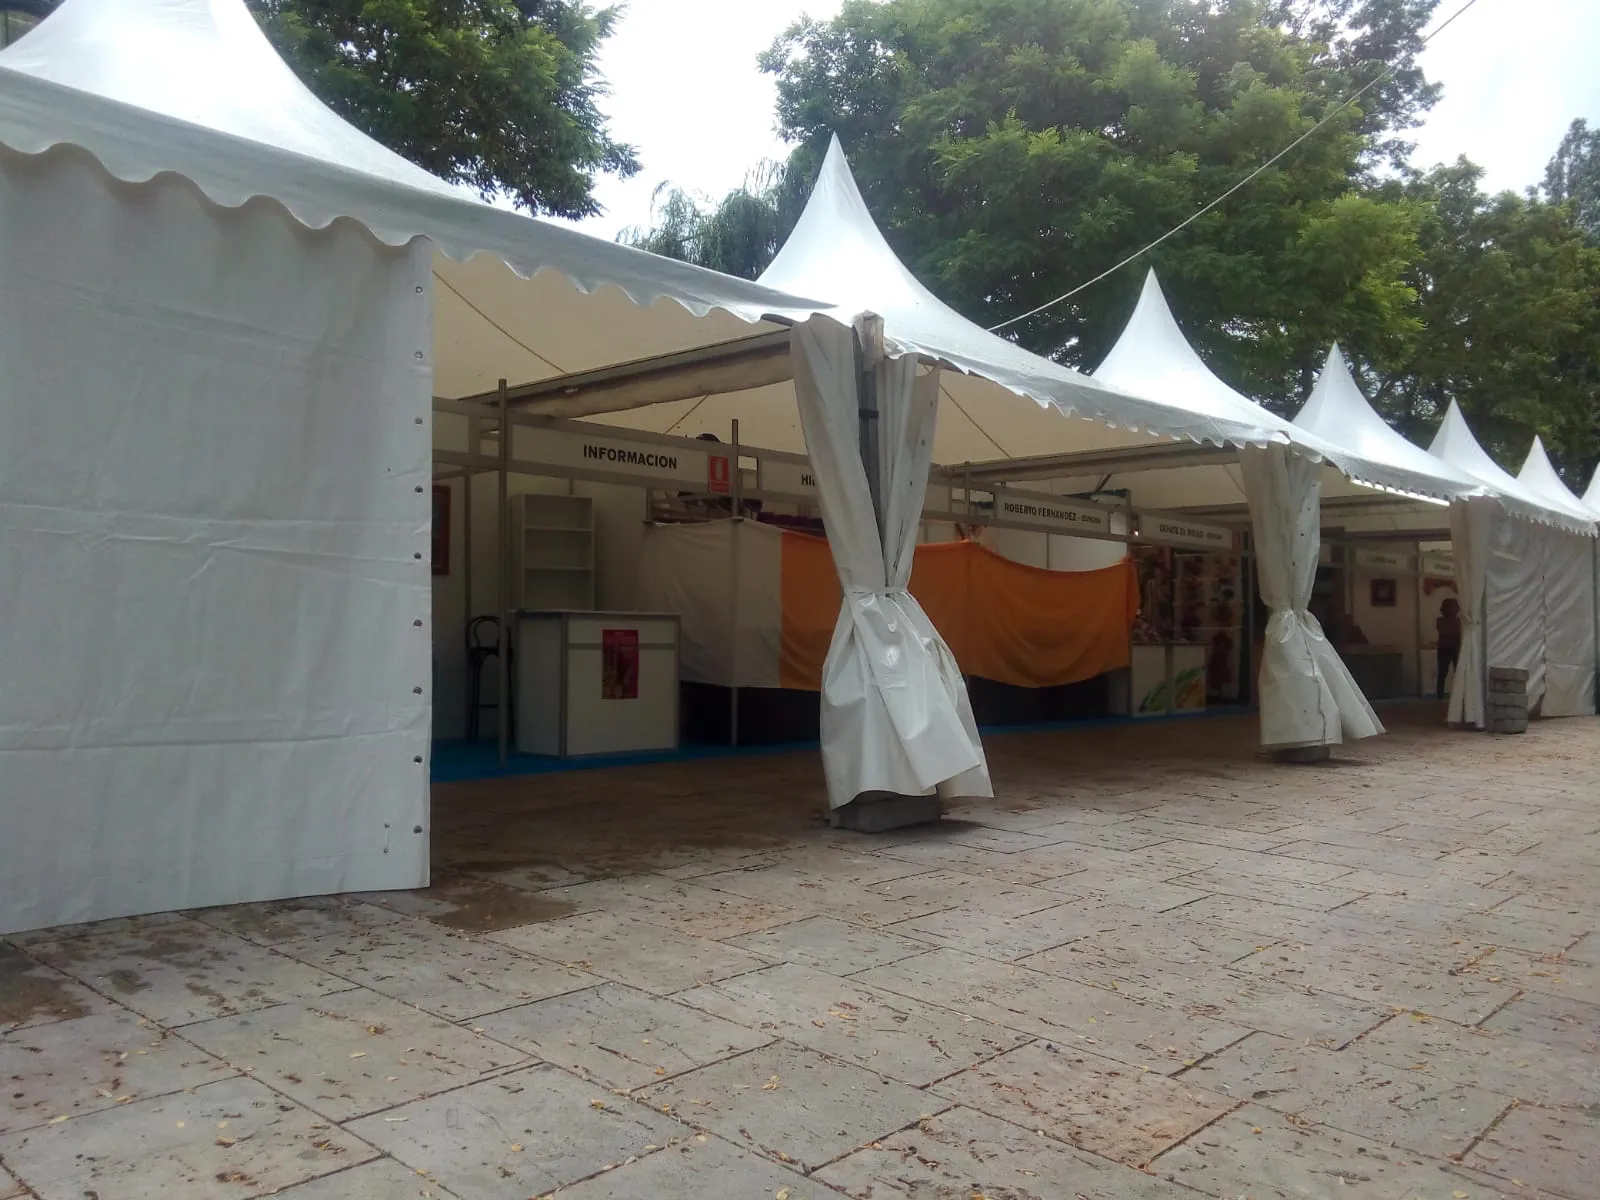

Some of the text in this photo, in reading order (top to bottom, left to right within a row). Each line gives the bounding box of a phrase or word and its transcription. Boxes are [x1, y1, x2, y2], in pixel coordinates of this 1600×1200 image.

[584, 444, 677, 469] INFORMACION
[1004, 502, 1037, 516] ROBERTO
[1038, 507, 1077, 521] FERNANDEZ
